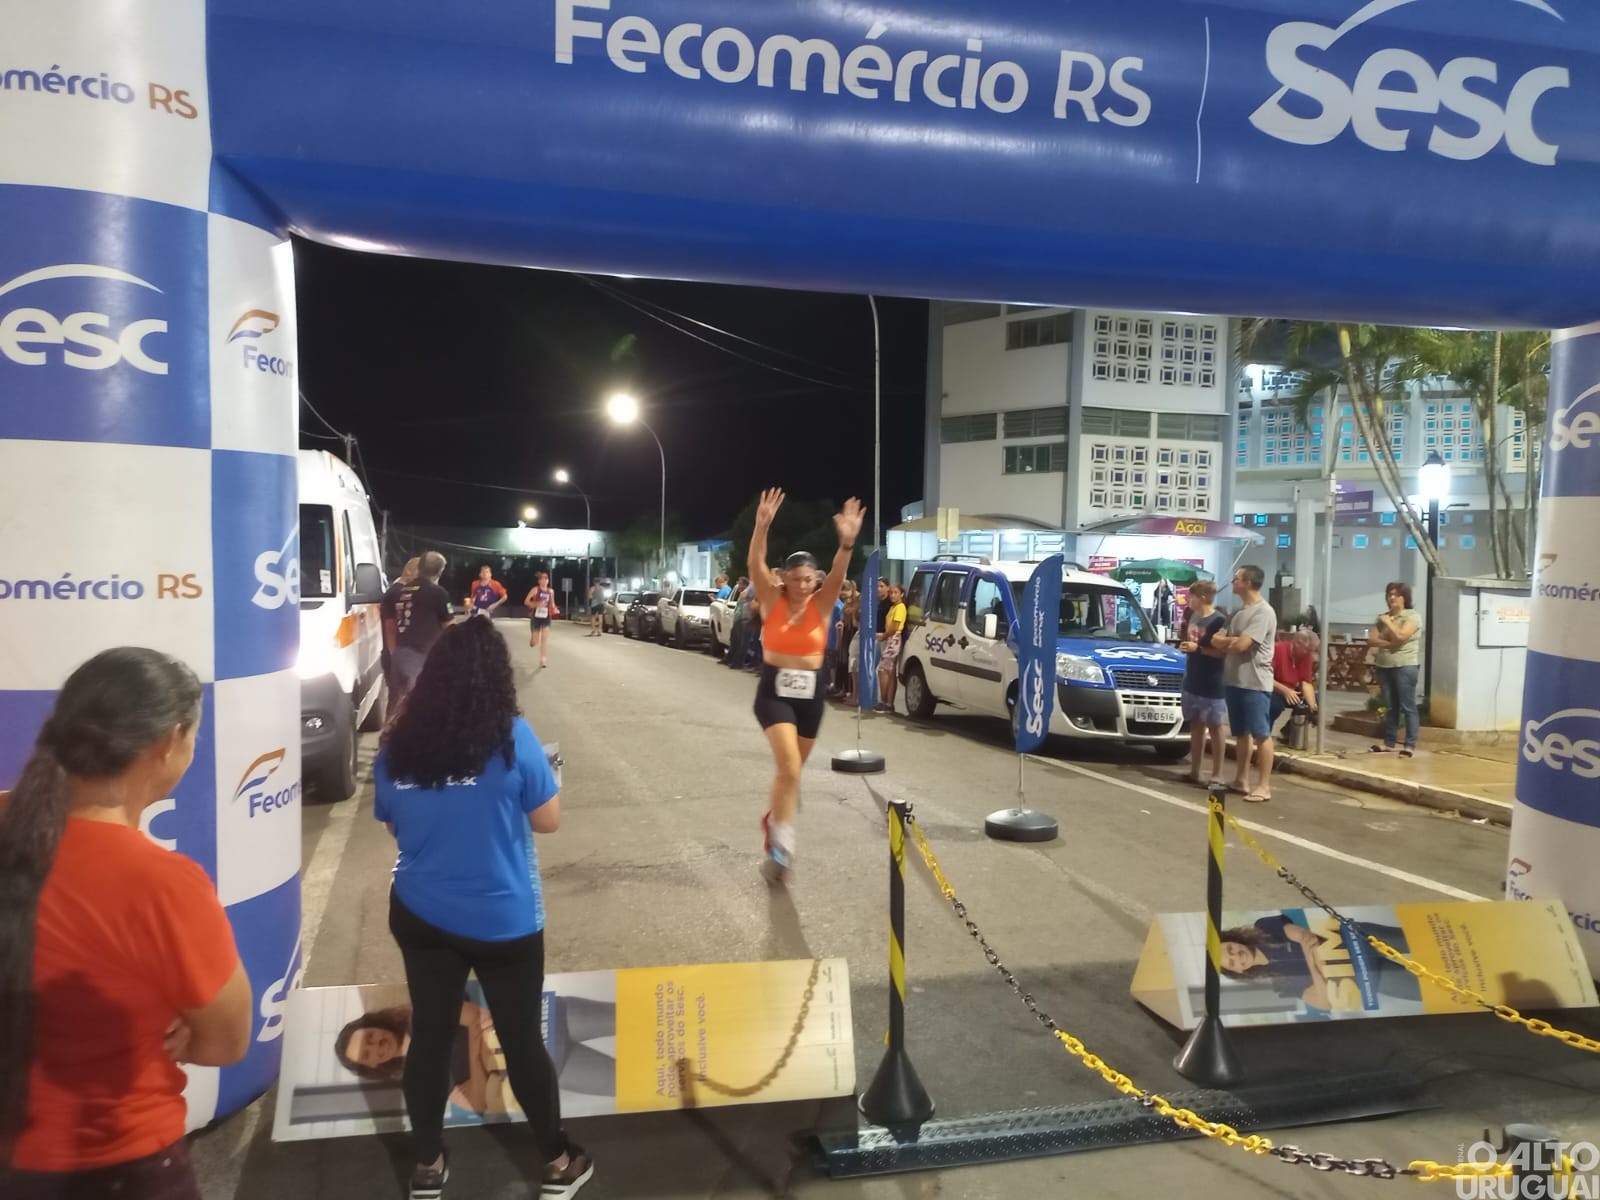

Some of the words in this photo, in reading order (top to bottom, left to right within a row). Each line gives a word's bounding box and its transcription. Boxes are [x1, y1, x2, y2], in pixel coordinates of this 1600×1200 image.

[555, 0, 1029, 113] Fecomércio
[1054, 49, 1152, 127] RS
[0, 64, 135, 104] mércio
[149, 82, 198, 119] RS
[1249, 0, 1570, 166] Sesc
[157, 573, 203, 599] RS
[925, 633, 946, 654] Sesc
[1025, 658, 1045, 738] Sesc
[656, 984, 664, 1025] mundo
[666, 982, 674, 994] os
[656, 1030, 665, 1059] todo
[666, 999, 675, 1062] aproveitar
[676, 1021, 685, 1036] do
[667, 1065, 676, 1098] pode
